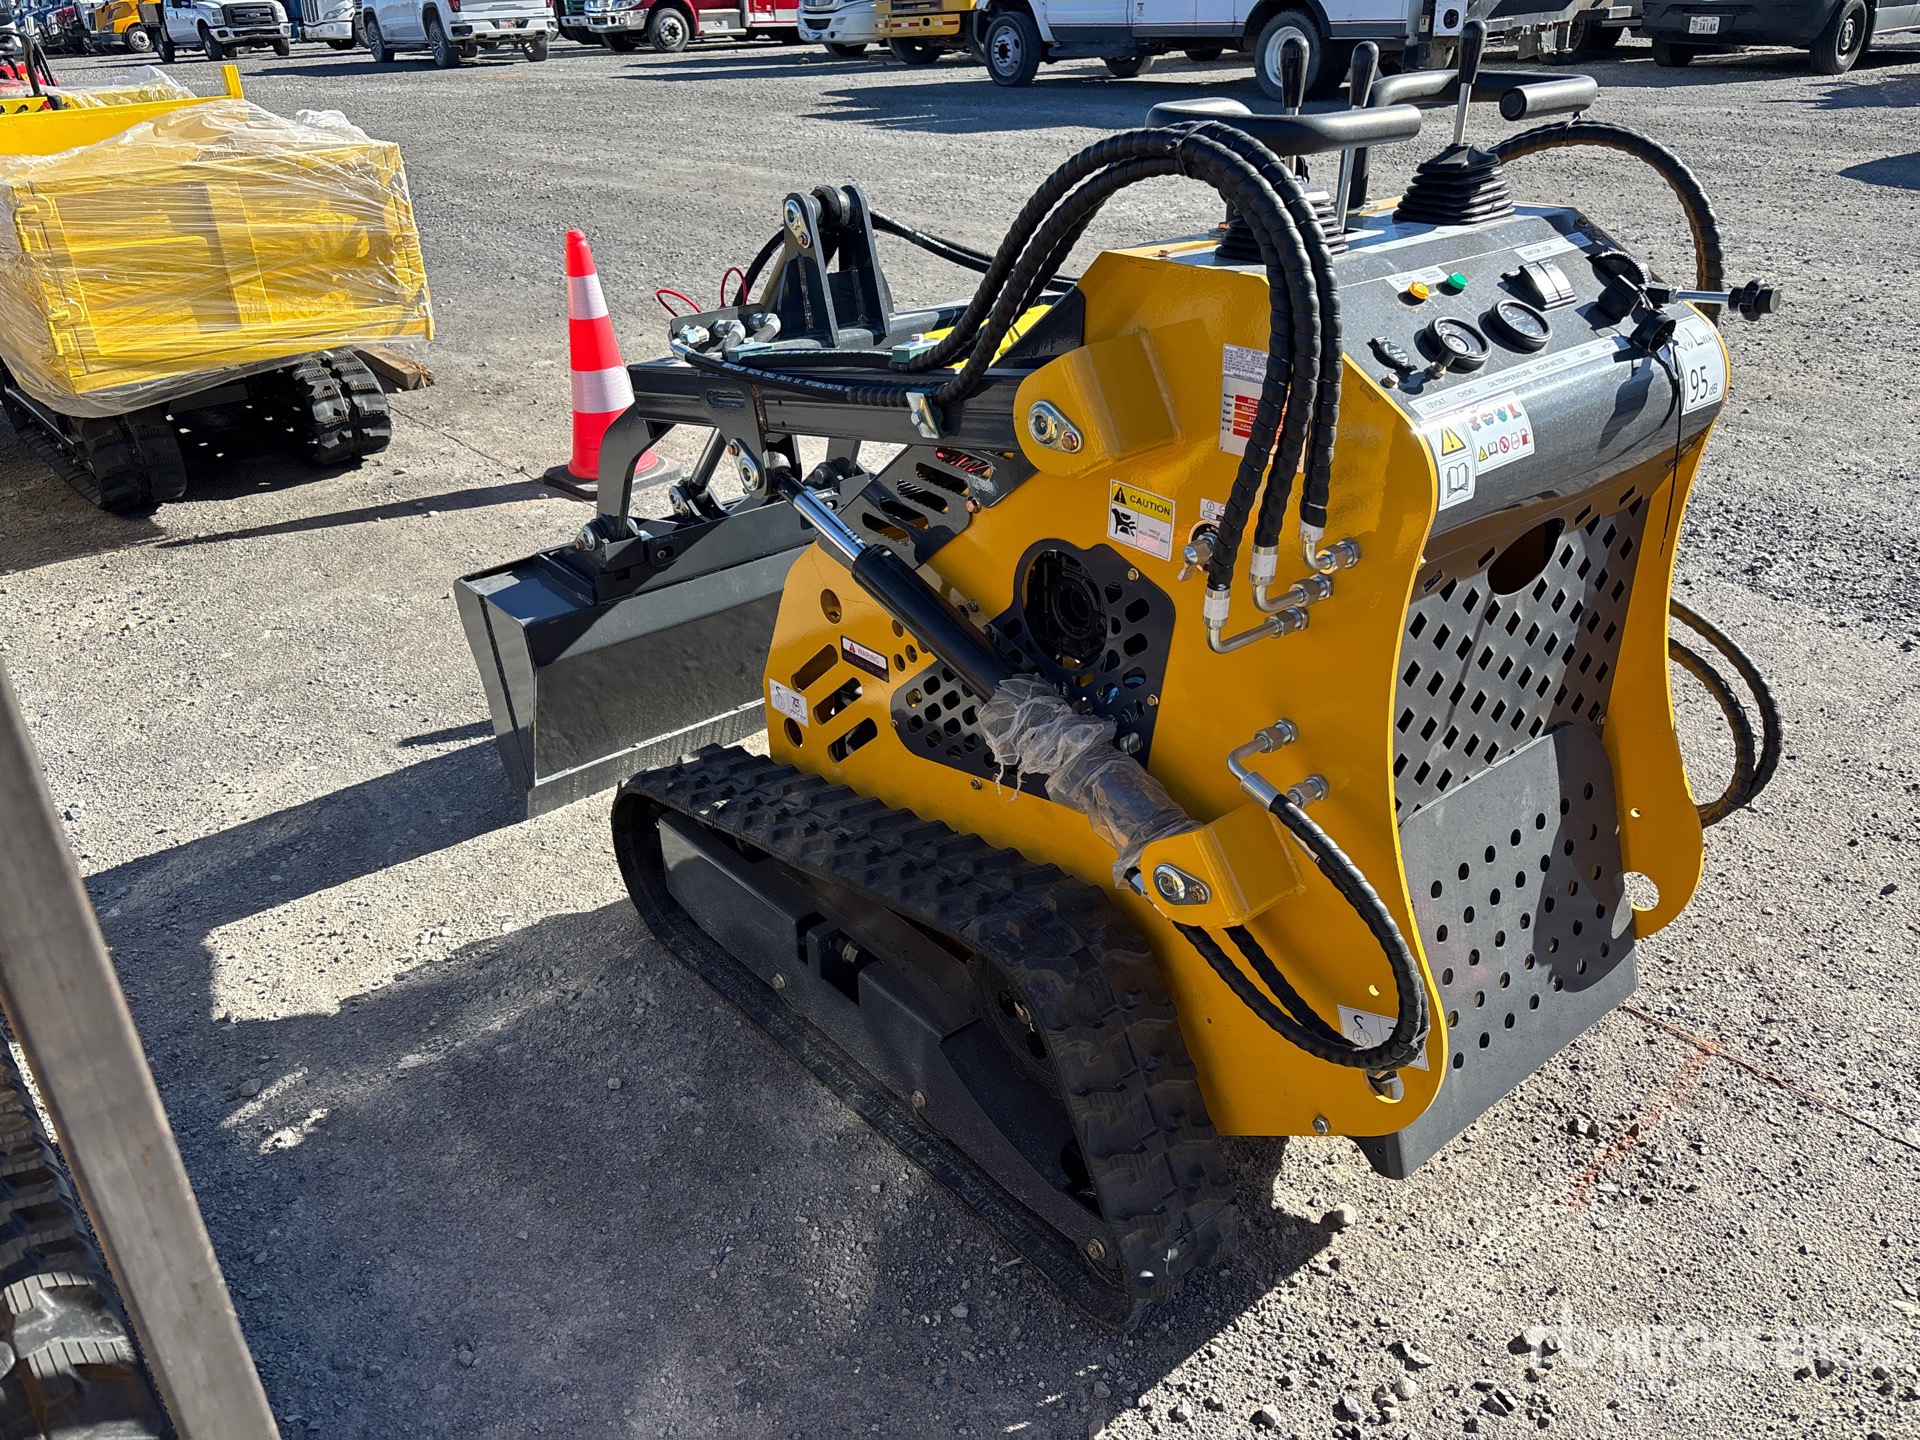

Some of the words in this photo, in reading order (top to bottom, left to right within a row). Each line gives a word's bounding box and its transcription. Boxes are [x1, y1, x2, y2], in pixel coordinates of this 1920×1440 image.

[1456, 387, 1477, 398] CHOKE
[1690, 365, 1708, 403] 95
[1709, 383, 1717, 396] dB
[1129, 494, 1171, 517] CAUTION
